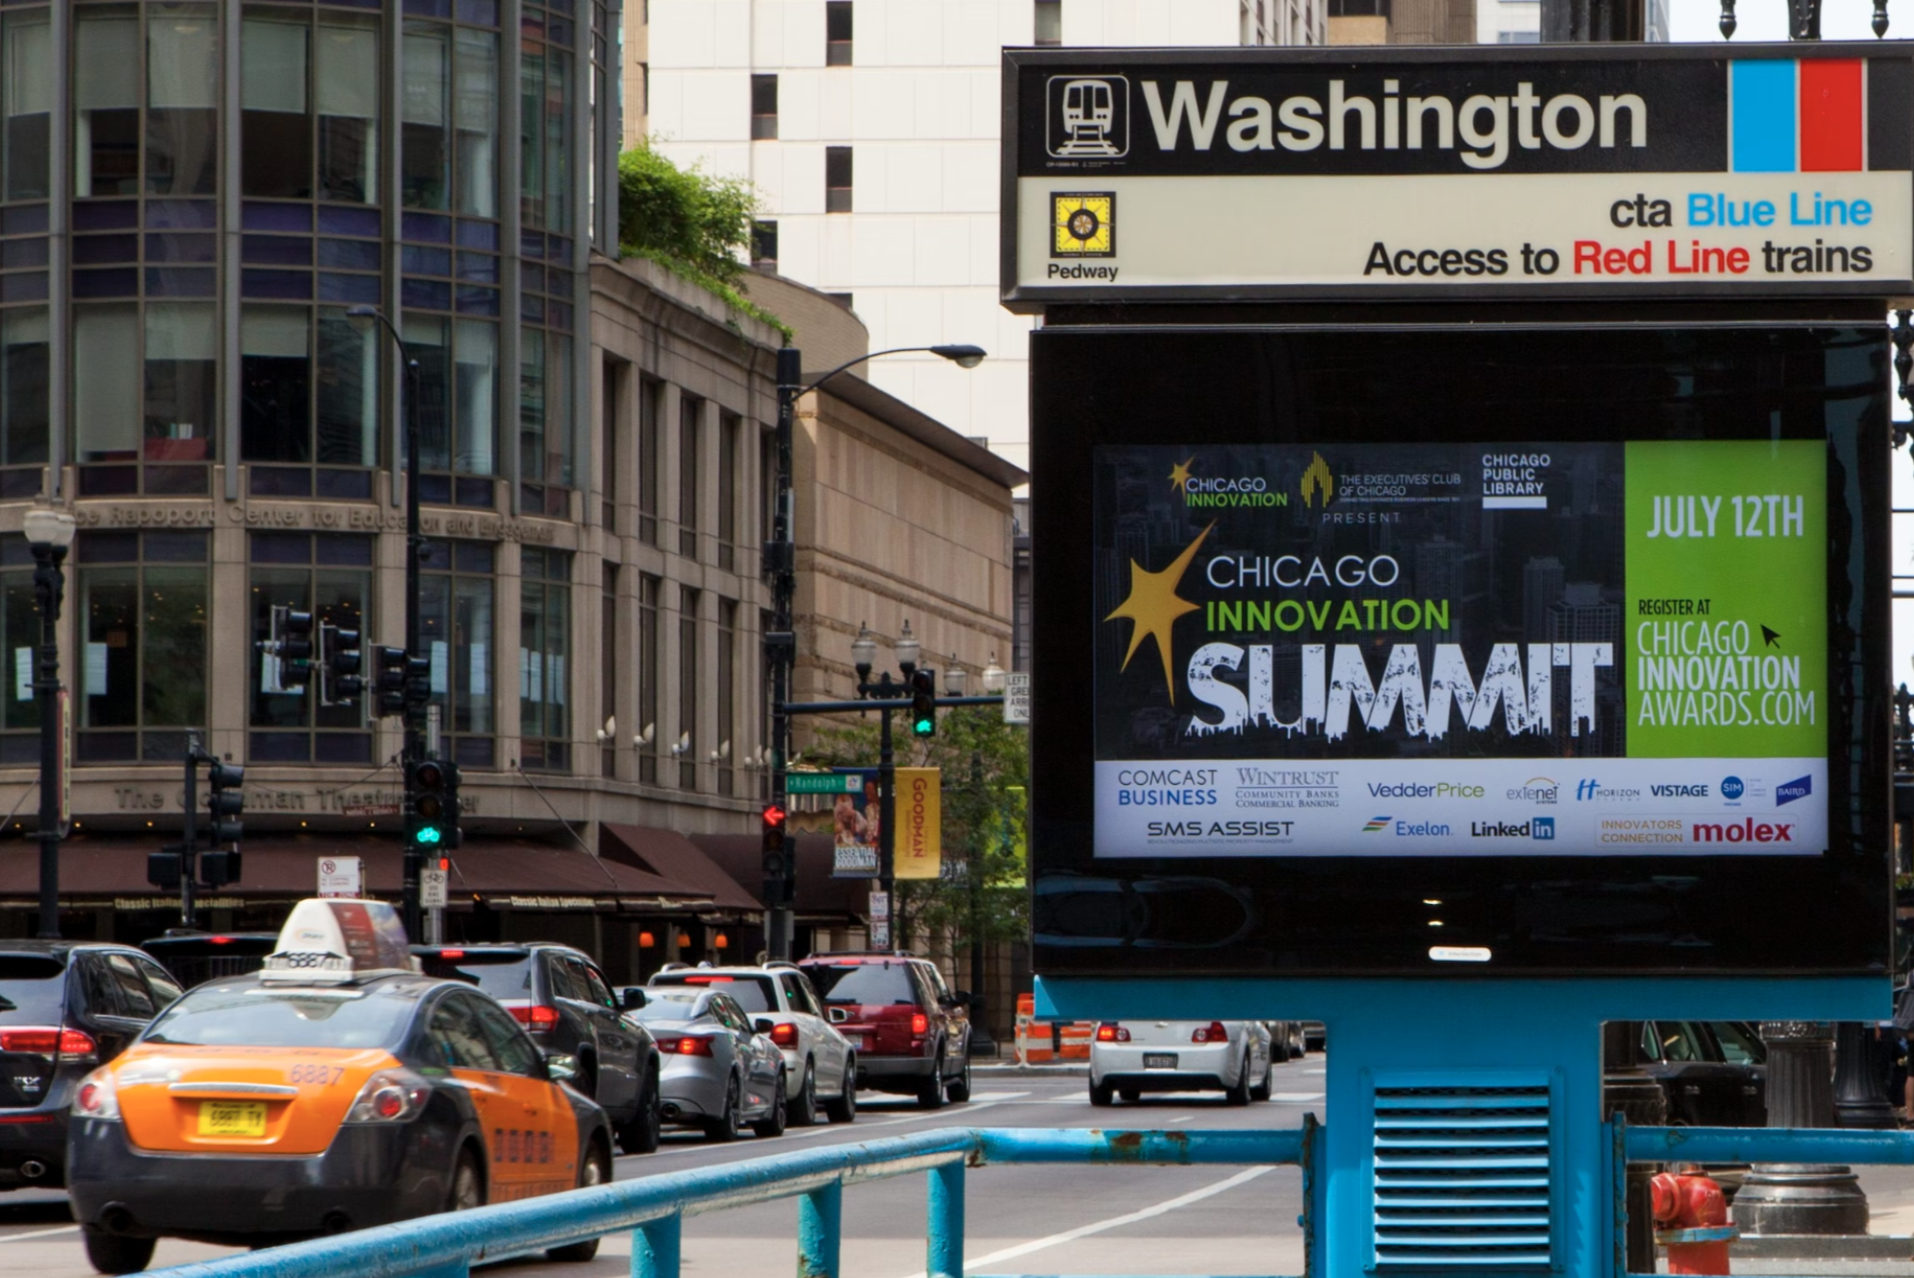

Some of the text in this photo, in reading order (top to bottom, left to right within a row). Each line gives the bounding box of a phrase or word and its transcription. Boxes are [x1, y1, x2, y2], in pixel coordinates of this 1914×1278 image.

[1140, 78, 1648, 170] Washington
[1609, 191, 1873, 228] cta Blue Line
[1363, 238, 1873, 276] Access to Red Line trains
[1047, 263, 1118, 282] Pedway
[1482, 453, 1550, 467] CHICAGO
[1340, 475, 1361, 485] THE
[1432, 474, 1461, 485] CLUB
[1482, 468, 1536, 481] PUBLIC
[1186, 477, 1267, 493] CHICAGO
[1339, 486, 1406, 496] OF CHICAGO
[1482, 482, 1544, 495] LIBRARY
[1186, 492, 1288, 507] INNOVATION
[227, 505, 304, 526] Center
[313, 508, 344, 527] for
[1322, 512, 1400, 524] PRESENT
[1647, 495, 1804, 538] JULY 12TH
[1206, 554, 1400, 588] CHICAGO
[1638, 599, 1711, 615] REGISTER AT
[1206, 599, 1450, 632] INNOVATION
[1637, 620, 1750, 655] CHICAGO
[1007, 676, 1028, 686] LEFT
[1638, 655, 1800, 691] INNOVATION
[1185, 642, 1614, 743] SUMMIT
[1638, 690, 1816, 726] AWARDS.COM
[795, 777, 837, 789] Randolph
[1118, 769, 1218, 786] COMCAST
[1367, 782, 1485, 798] VedderPrice
[1596, 788, 1640, 797] HORIZON
[1651, 784, 1709, 797] VISTAGE
[1722, 783, 1742, 792] SIM
[1777, 787, 1806, 796] BAIRD
[114, 787, 164, 809] The
[1118, 789, 1218, 806] BUSINESS
[912, 777, 928, 859] GOODMAN
[1601, 819, 1683, 830] INNOVATORS
[1147, 821, 1295, 836] SMS ASSIST
[1396, 820, 1451, 836] Exelon
[1692, 817, 1793, 843] molex
[1601, 832, 1683, 843] CONNECTION
[288, 952, 328, 969] 6887
[290, 1063, 345, 1087] 6887
